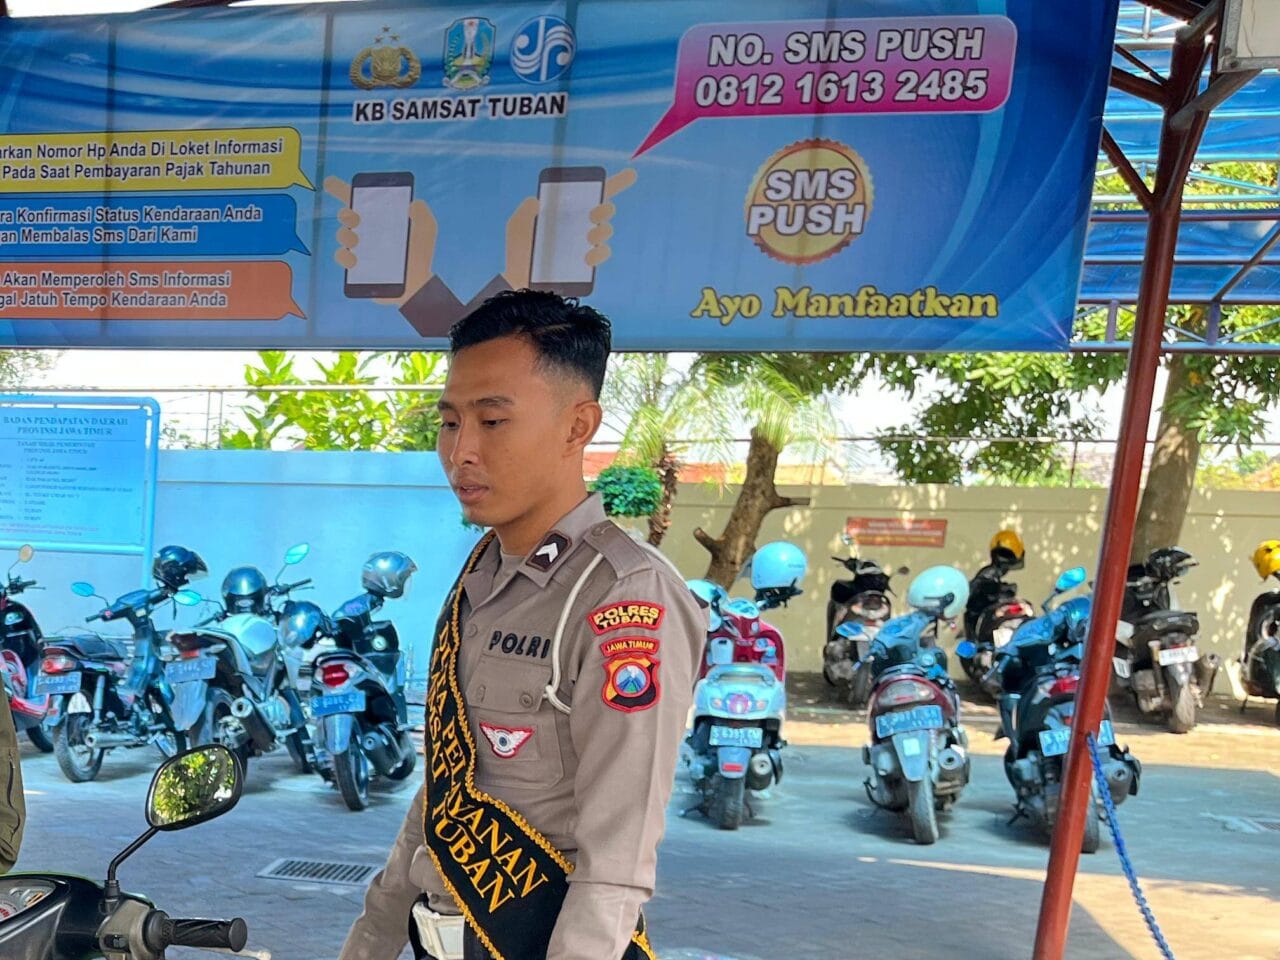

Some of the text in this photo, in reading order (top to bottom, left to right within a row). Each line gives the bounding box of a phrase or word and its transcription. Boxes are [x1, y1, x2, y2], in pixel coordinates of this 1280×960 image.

[709, 27, 985, 66] NO. SMS PUSH
[695, 68, 988, 107] 0812 1613 2485
[355, 95, 566, 122] KB SAMSAT TUBAN
[37, 144, 83, 159] Nomor
[86, 143, 106, 162] Hp
[109, 142, 146, 157] Anda
[151, 141, 165, 156] Di
[170, 140, 210, 155] Loket
[214, 138, 283, 154] Informasi
[3, 165, 36, 179] Pada
[40, 164, 70, 178] Saat
[74, 163, 161, 181] Pembayaran
[165, 162, 204, 180] Pajak
[209, 161, 270, 176] Tahunan
[764, 168, 856, 201] SMS
[17, 207, 91, 223] Konfirmasi
[95, 207, 139, 222] Status
[144, 206, 220, 221] Kendaraan
[224, 205, 261, 220] Anda
[746, 203, 865, 236] PUSH
[21, 229, 89, 243] Membalas
[93, 228, 124, 242] Sms
[128, 227, 156, 242] Dari
[161, 226, 197, 241] Kami
[3, 273, 37, 286] Akan
[41, 272, 124, 290] Memperoleh
[129, 272, 159, 286] Sms
[164, 271, 230, 286] Informasi
[20, 292, 58, 306] Jatuh
[62, 292, 107, 310] Tempo
[111, 292, 186, 306] Kendaraan
[189, 292, 226, 306] Anda
[690, 285, 998, 325] Ayo Manfaatkan
[593, 605, 659, 625] POLRES
[600, 615, 655, 628] TUBAN
[489, 630, 551, 659] POLRI
[607, 640, 654, 652] JAWA TIMUR
[442, 715, 549, 898] PELAYANAN
[431, 791, 515, 913] TUBAN
